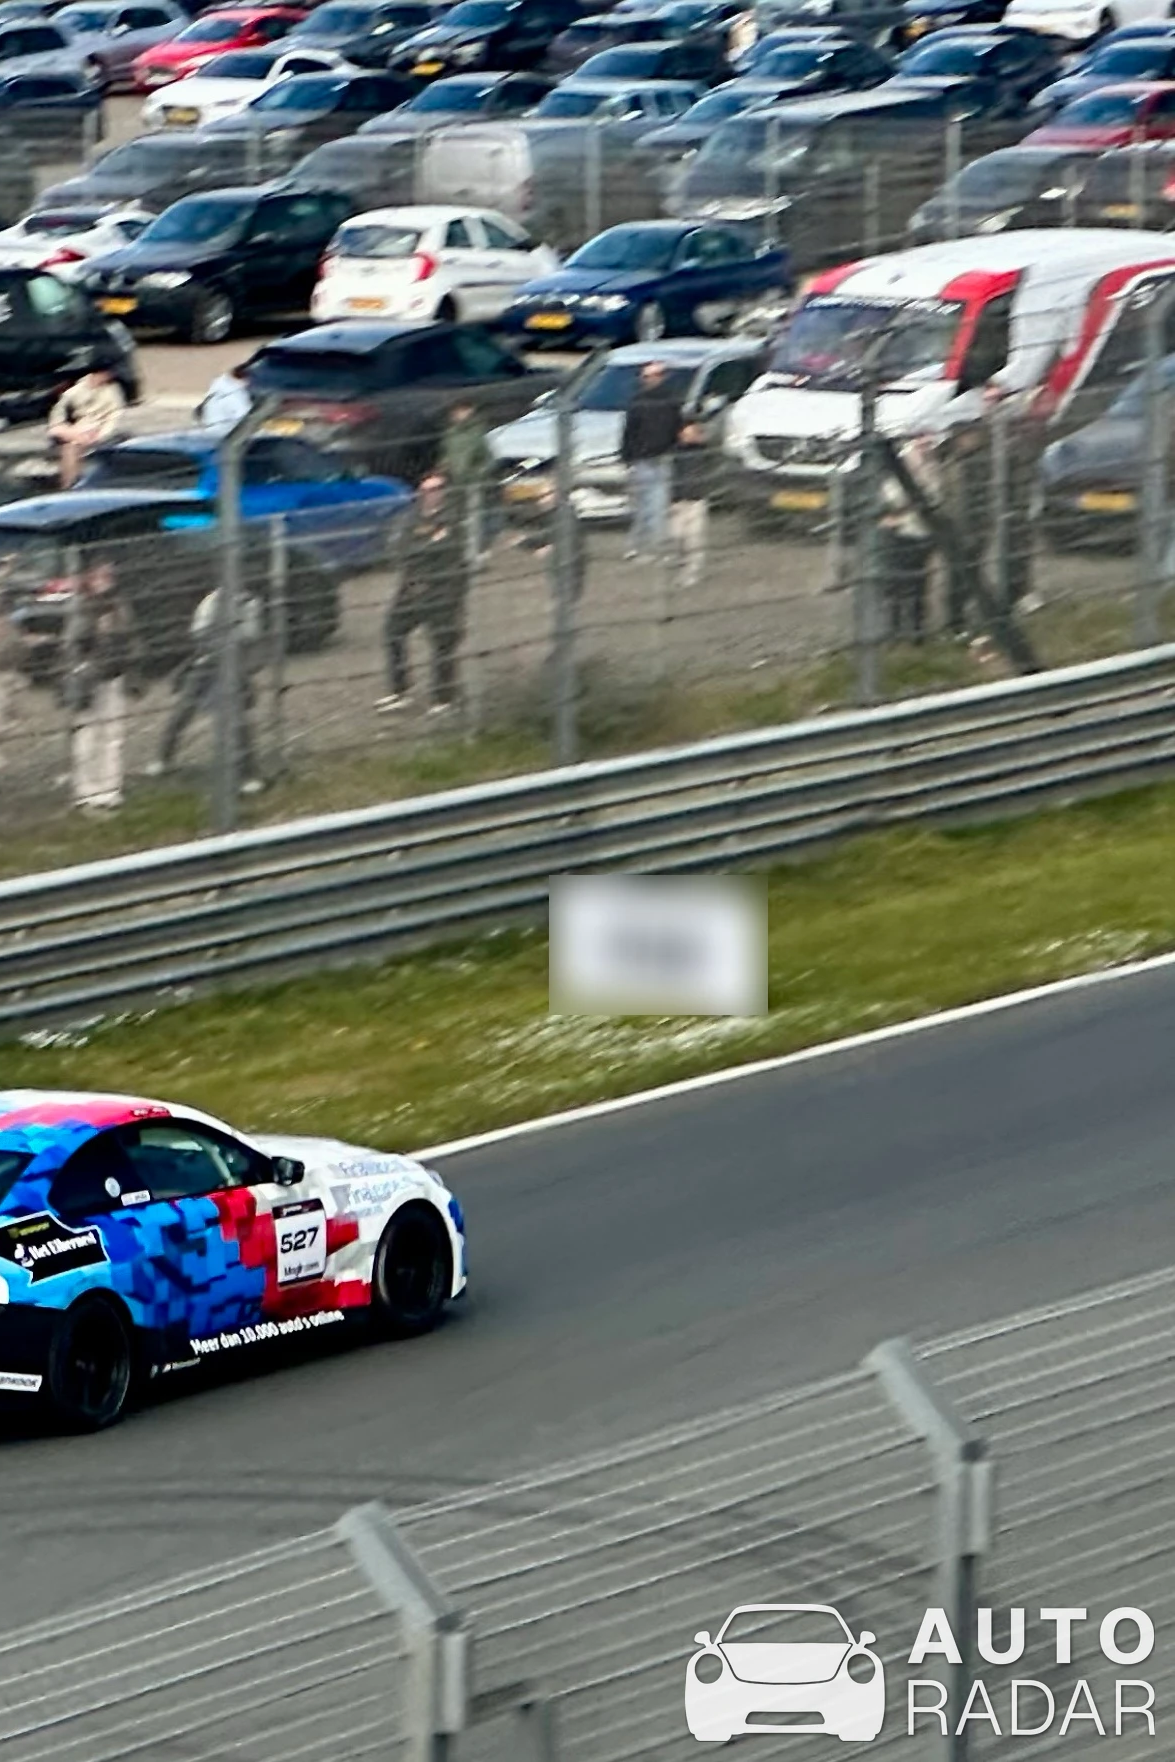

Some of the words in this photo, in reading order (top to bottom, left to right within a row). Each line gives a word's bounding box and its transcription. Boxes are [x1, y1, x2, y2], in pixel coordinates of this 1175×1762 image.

[280, 1225, 320, 1254] 527
[190, 1338, 220, 1354] Meer
[220, 1332, 242, 1349] dan
